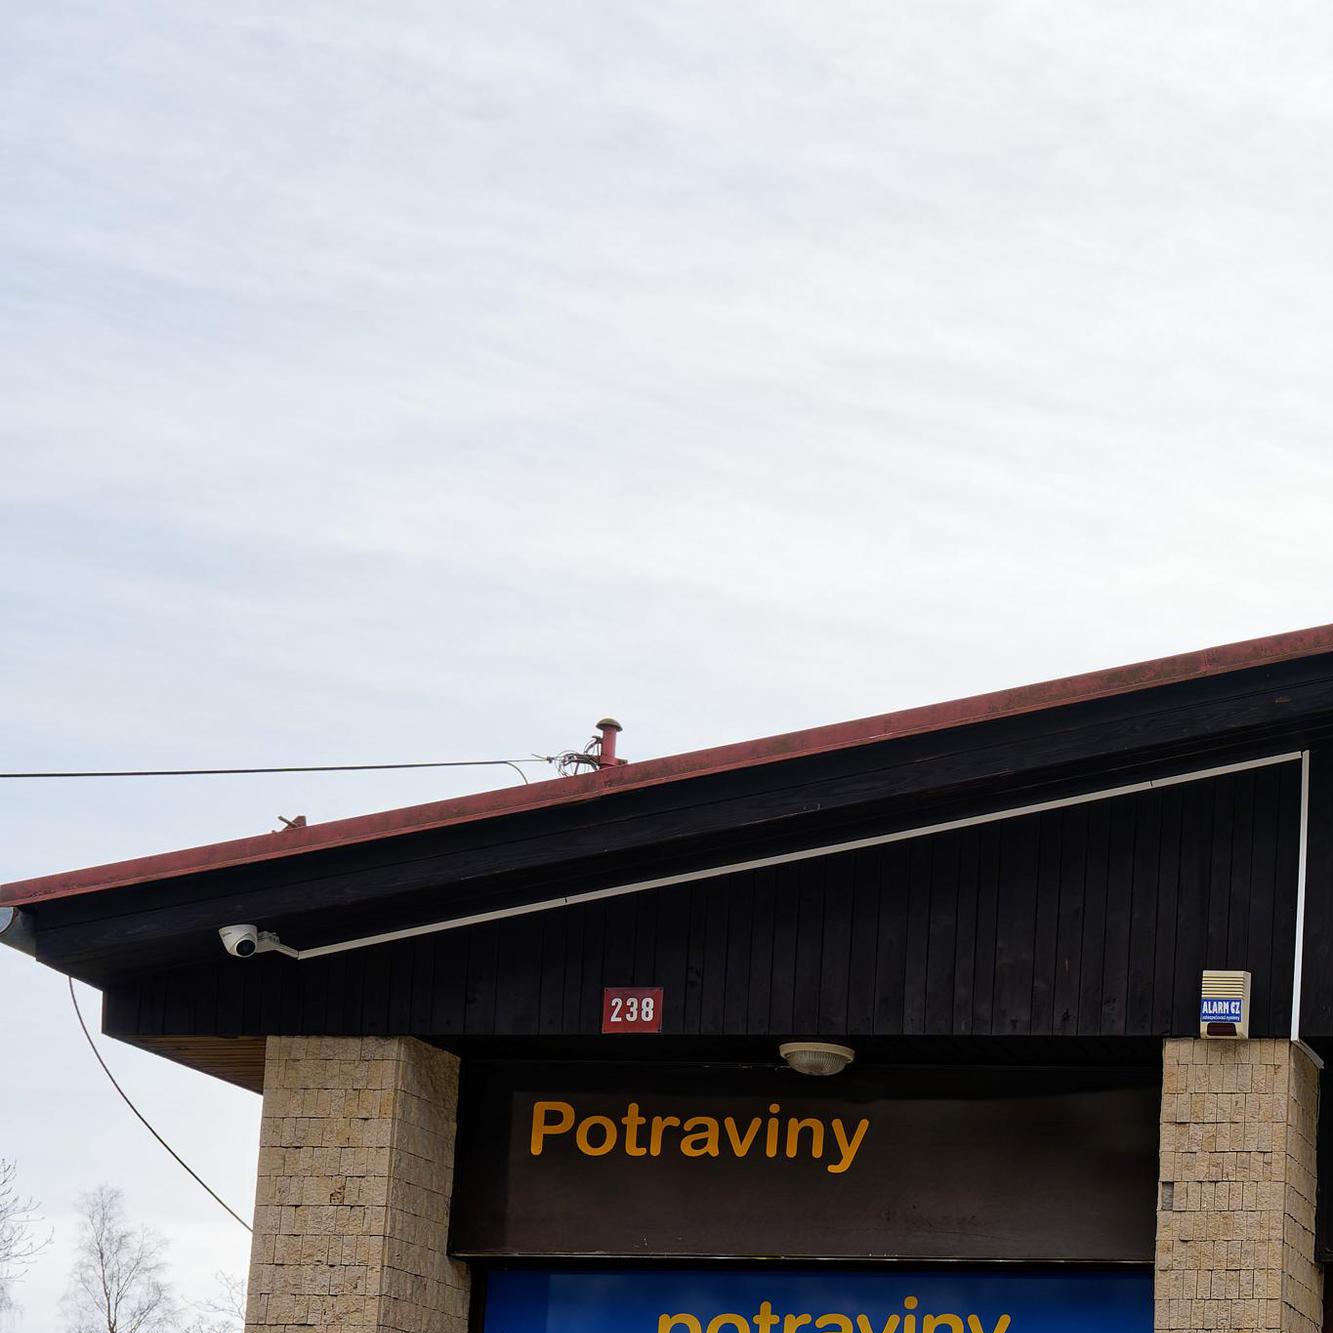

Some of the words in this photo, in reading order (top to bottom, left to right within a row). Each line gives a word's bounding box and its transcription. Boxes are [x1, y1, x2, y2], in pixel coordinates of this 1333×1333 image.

[611, 998, 654, 1022] 238
[1202, 1001, 1229, 1014] ALARM
[1230, 1001, 1240, 1014] CZ
[531, 1102, 868, 1173] Potraviny
